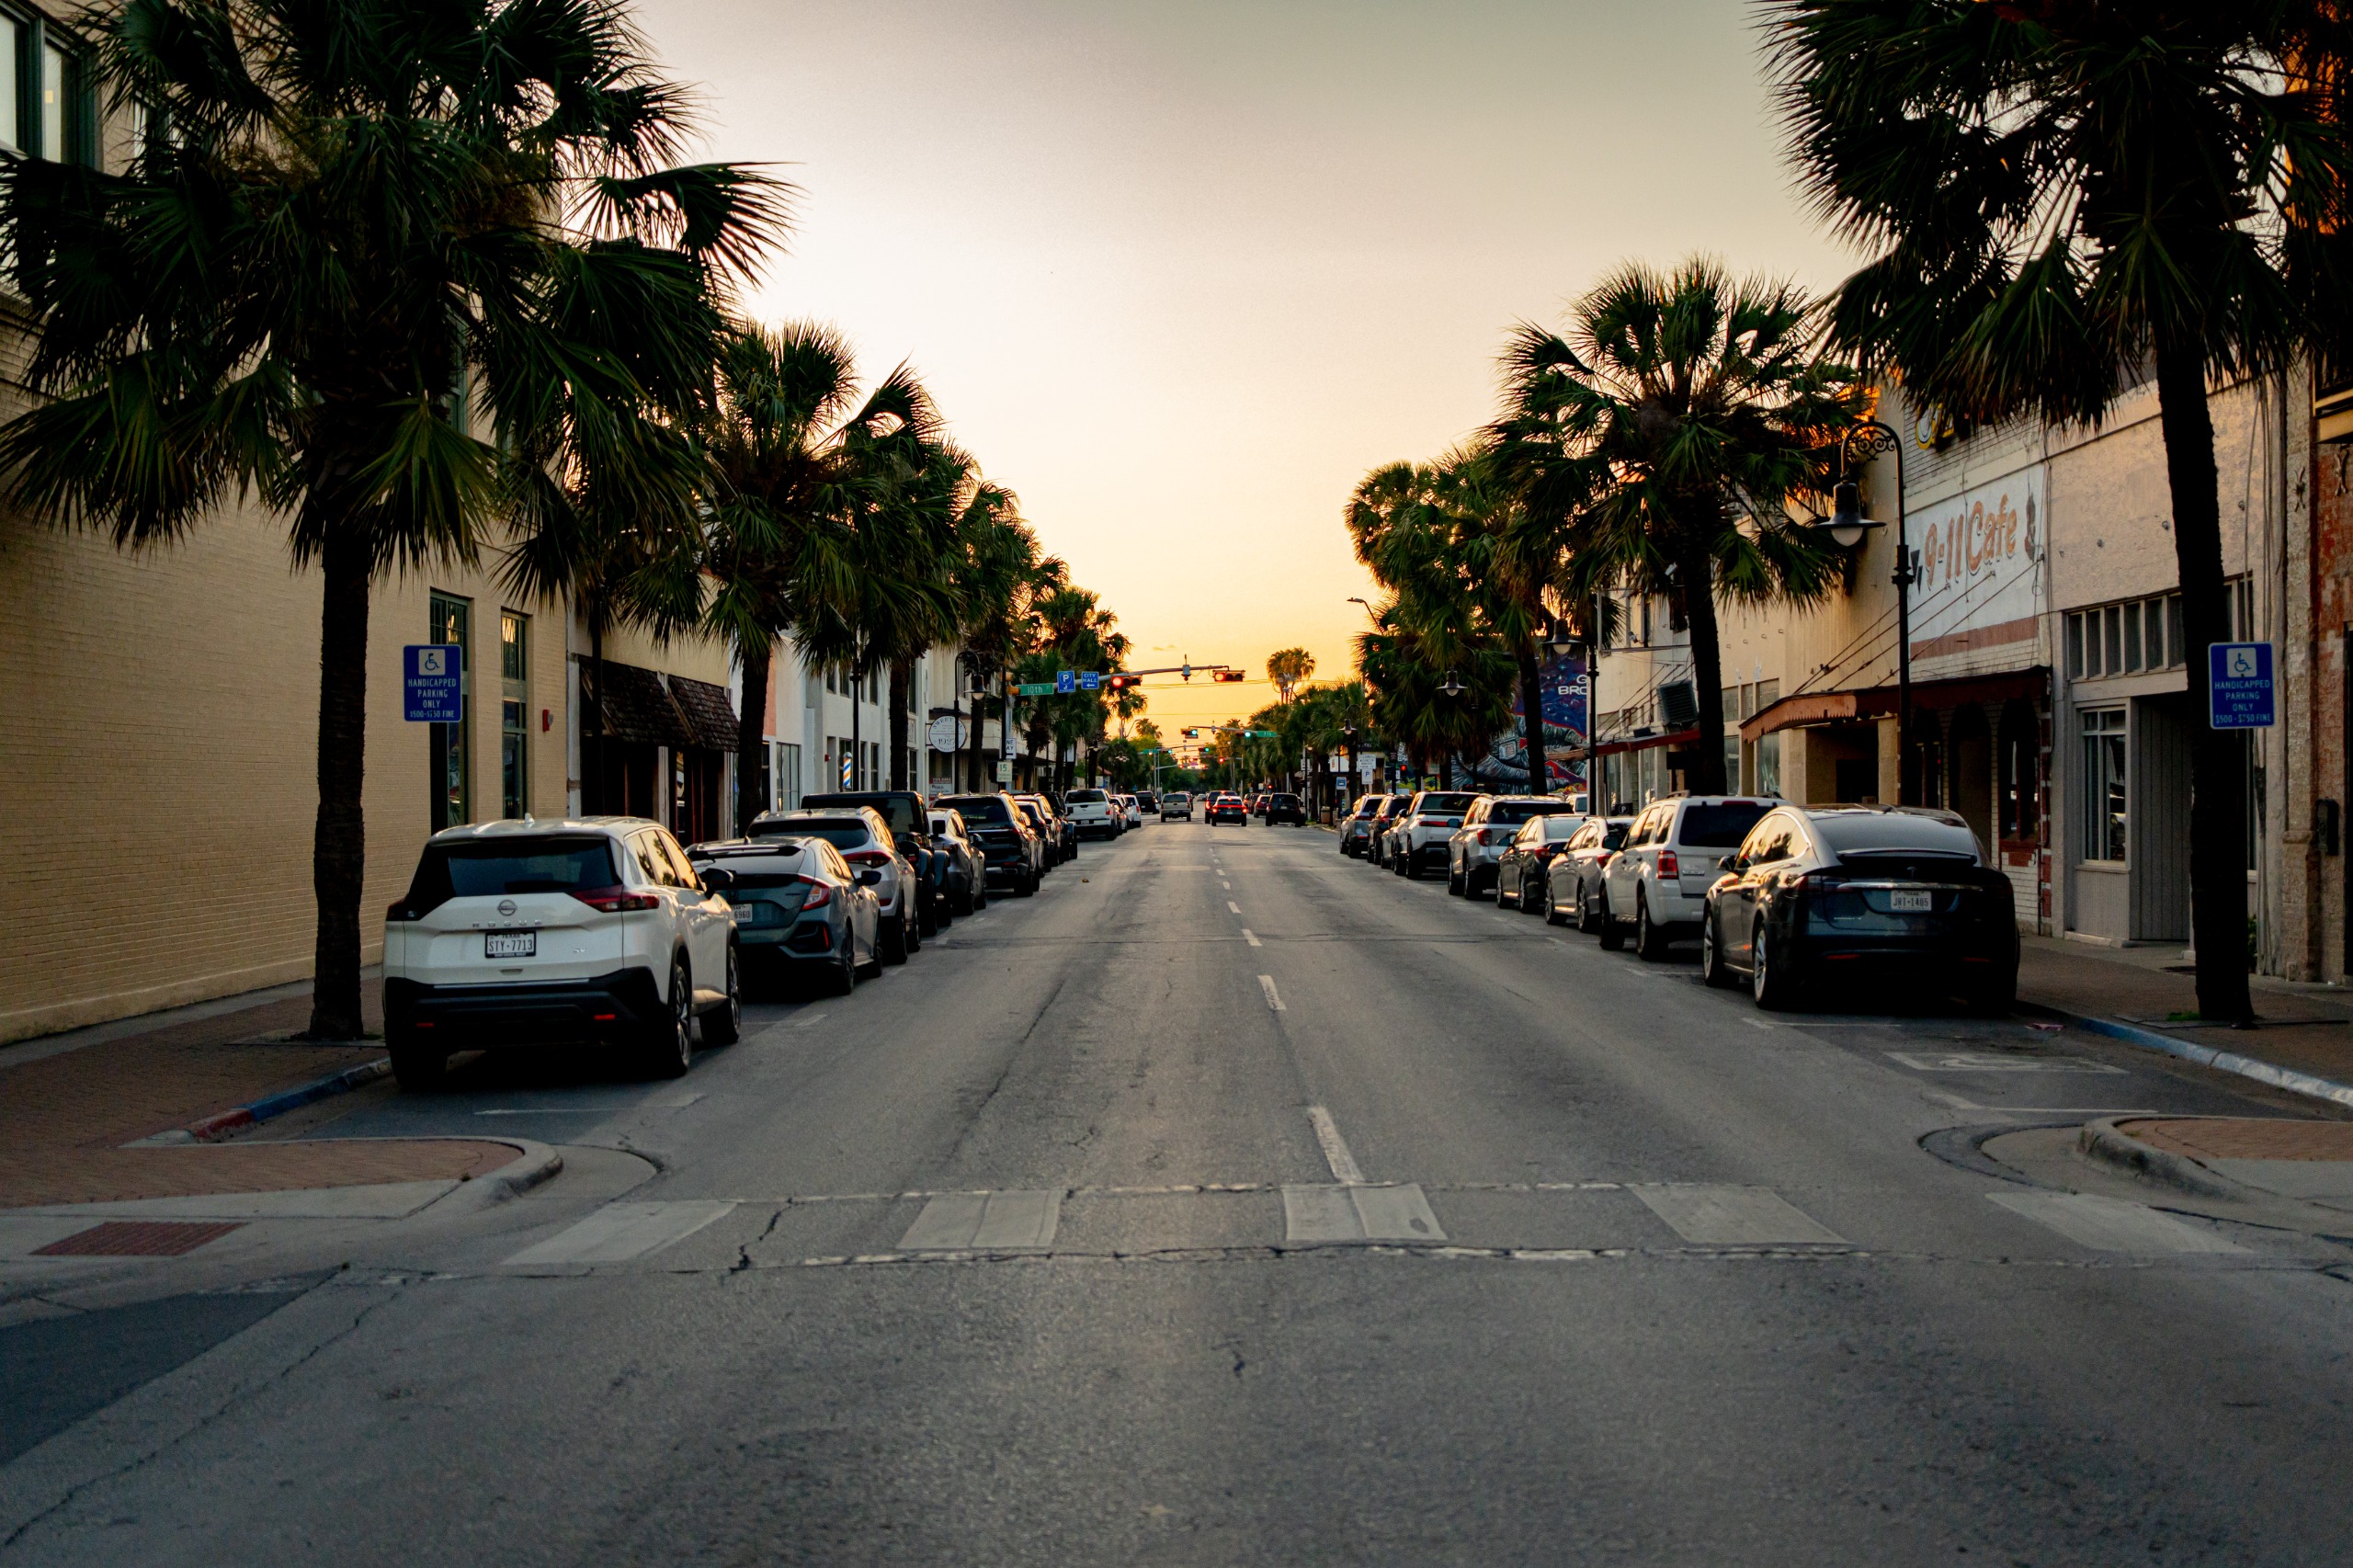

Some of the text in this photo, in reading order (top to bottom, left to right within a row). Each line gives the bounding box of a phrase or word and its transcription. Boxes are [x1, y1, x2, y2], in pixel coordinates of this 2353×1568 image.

[1967, 493, 2018, 574] Cafe
[407, 678, 457, 687] HANDICAPPED
[1063, 674, 1069, 682] P
[2214, 679, 2270, 690] HANDICAPPED
[417, 688, 449, 699] PARKING
[1027, 686, 1043, 694] 10th
[2225, 691, 2260, 700] PARKING
[423, 699, 441, 709] ONLY
[2232, 703, 2254, 711] ONLY
[442, 710, 455, 718] FINE
[2256, 713, 2271, 722] FINE
[472, 920, 542, 928] ROGUE
